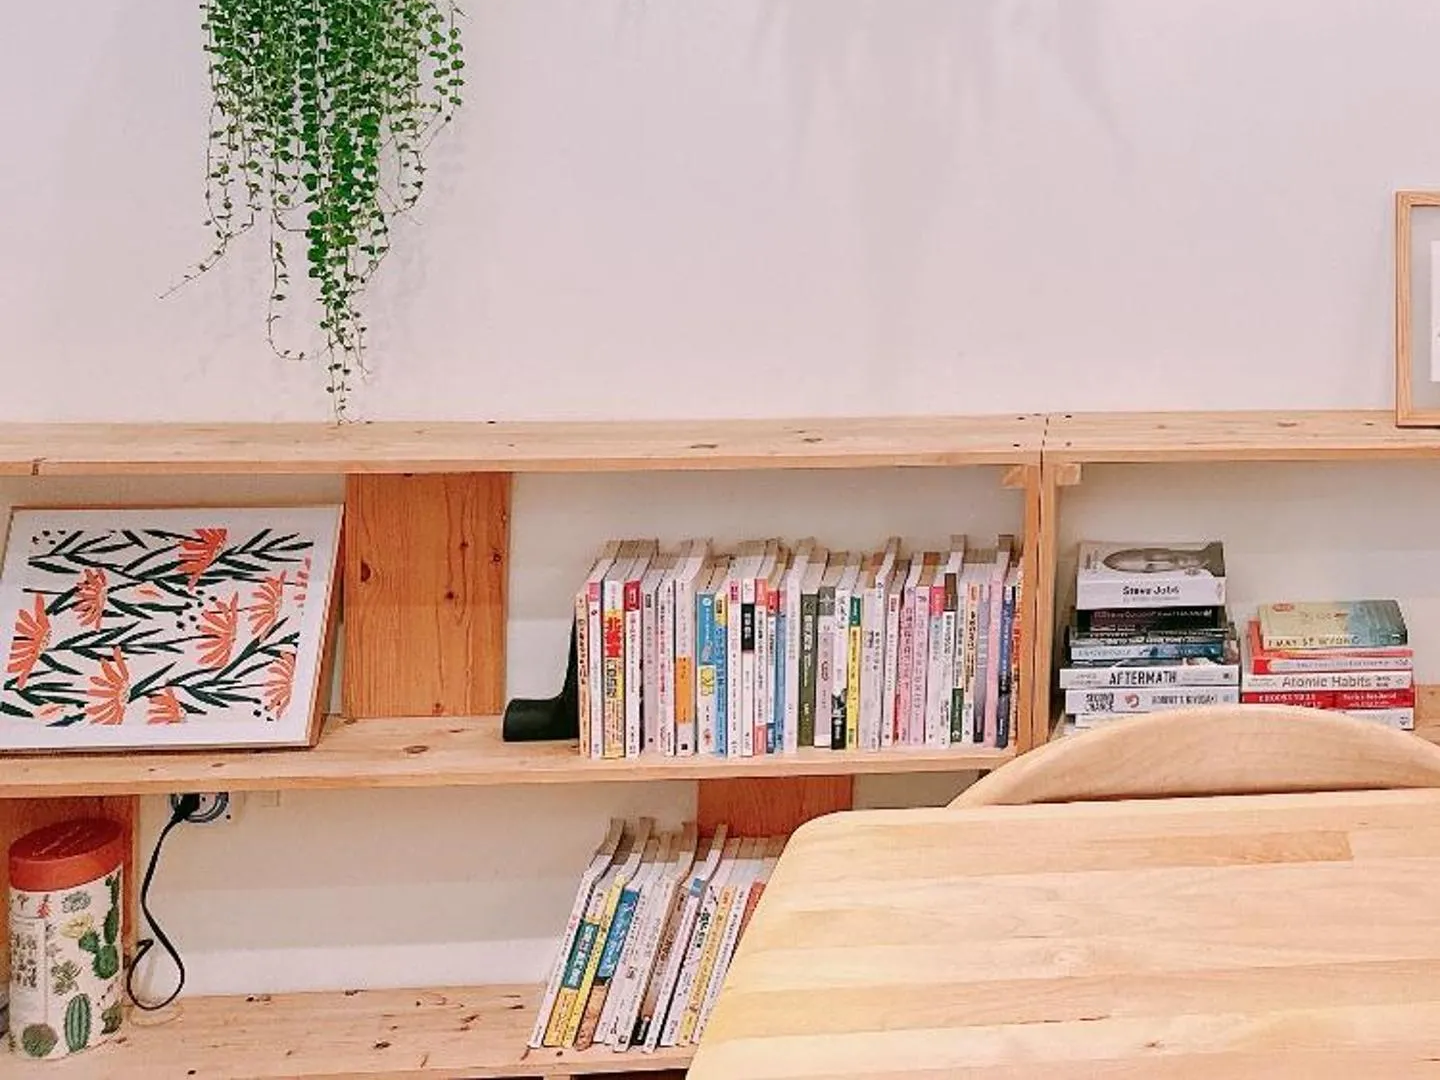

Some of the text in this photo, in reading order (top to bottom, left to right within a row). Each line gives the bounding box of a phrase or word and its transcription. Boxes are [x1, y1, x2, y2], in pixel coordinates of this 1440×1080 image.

[1122, 585, 1151, 595] Steve
[1108, 670, 1177, 686] AFTERMATH
[1281, 676, 1327, 688] Atomic
[1331, 675, 1372, 687] Habits
